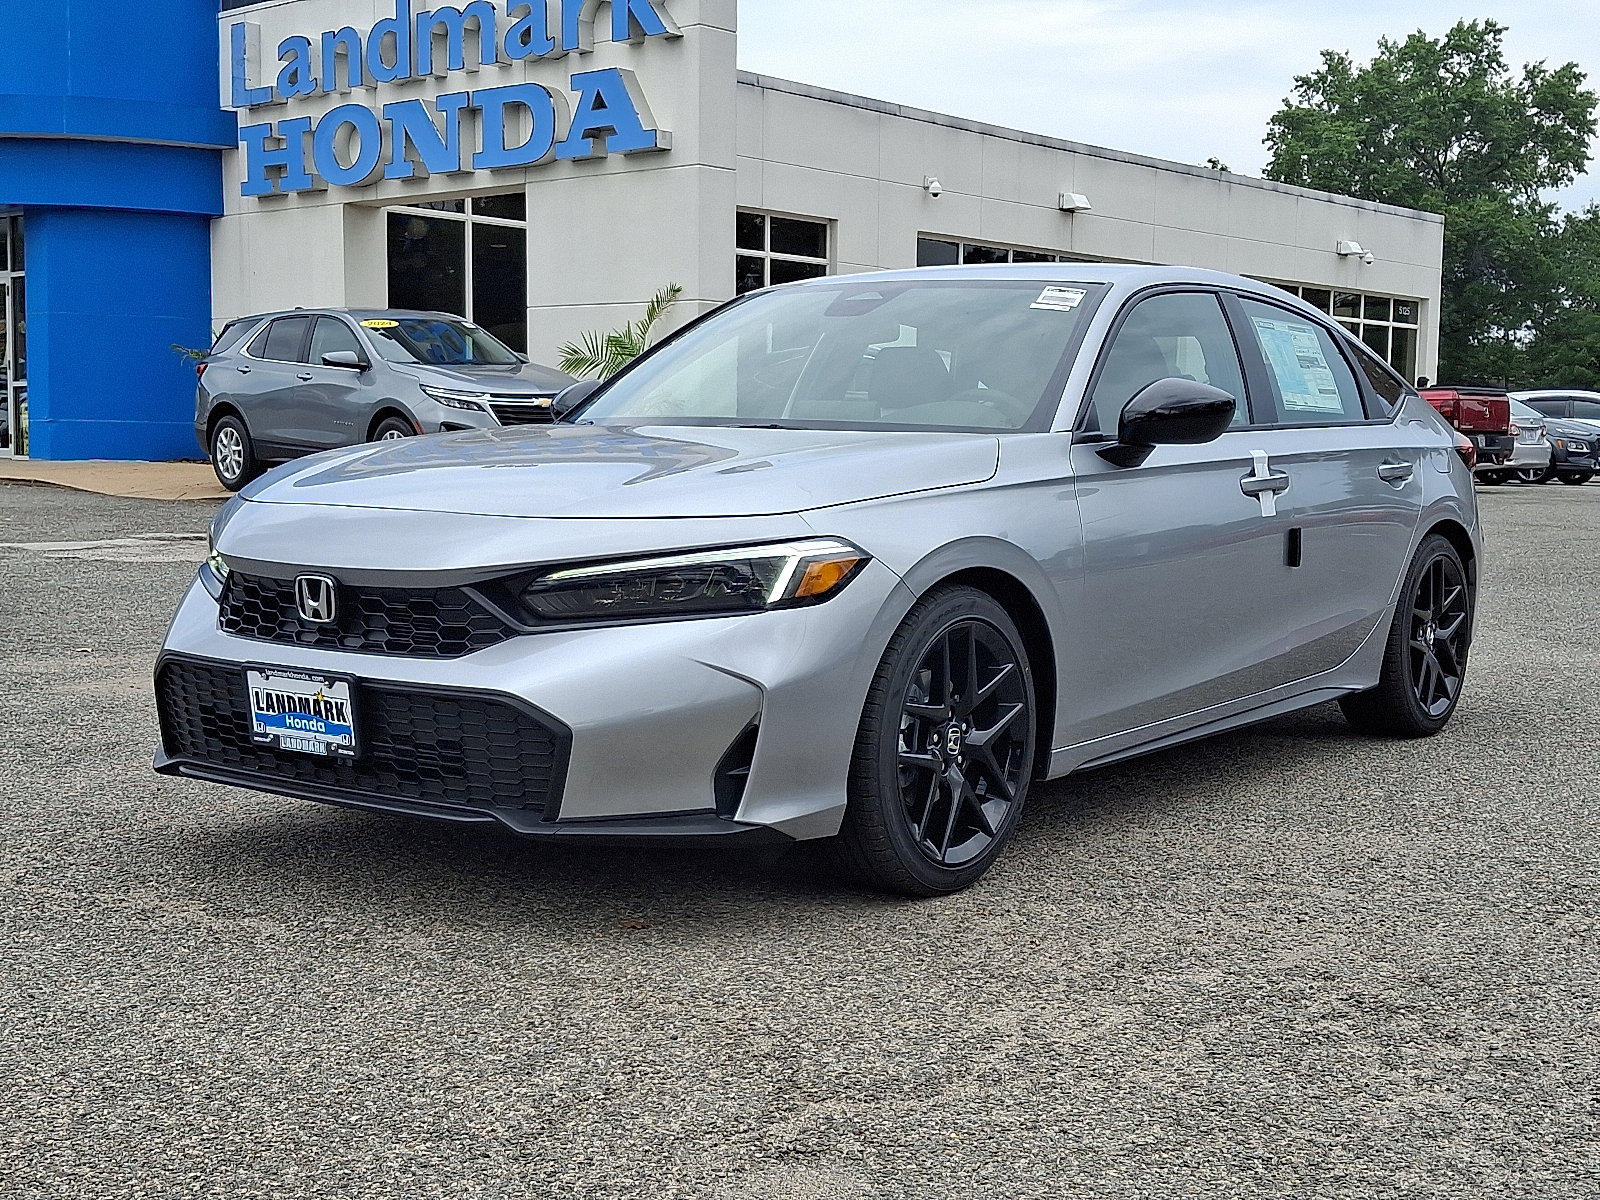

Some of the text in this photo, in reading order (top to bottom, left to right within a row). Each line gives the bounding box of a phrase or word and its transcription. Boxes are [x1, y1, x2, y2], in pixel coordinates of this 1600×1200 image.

[239, 67, 659, 197] HONDA
[253, 689, 348, 724] LANDMARK
[285, 714, 326, 733] Honda
[281, 736, 327, 754] LANDMARK
